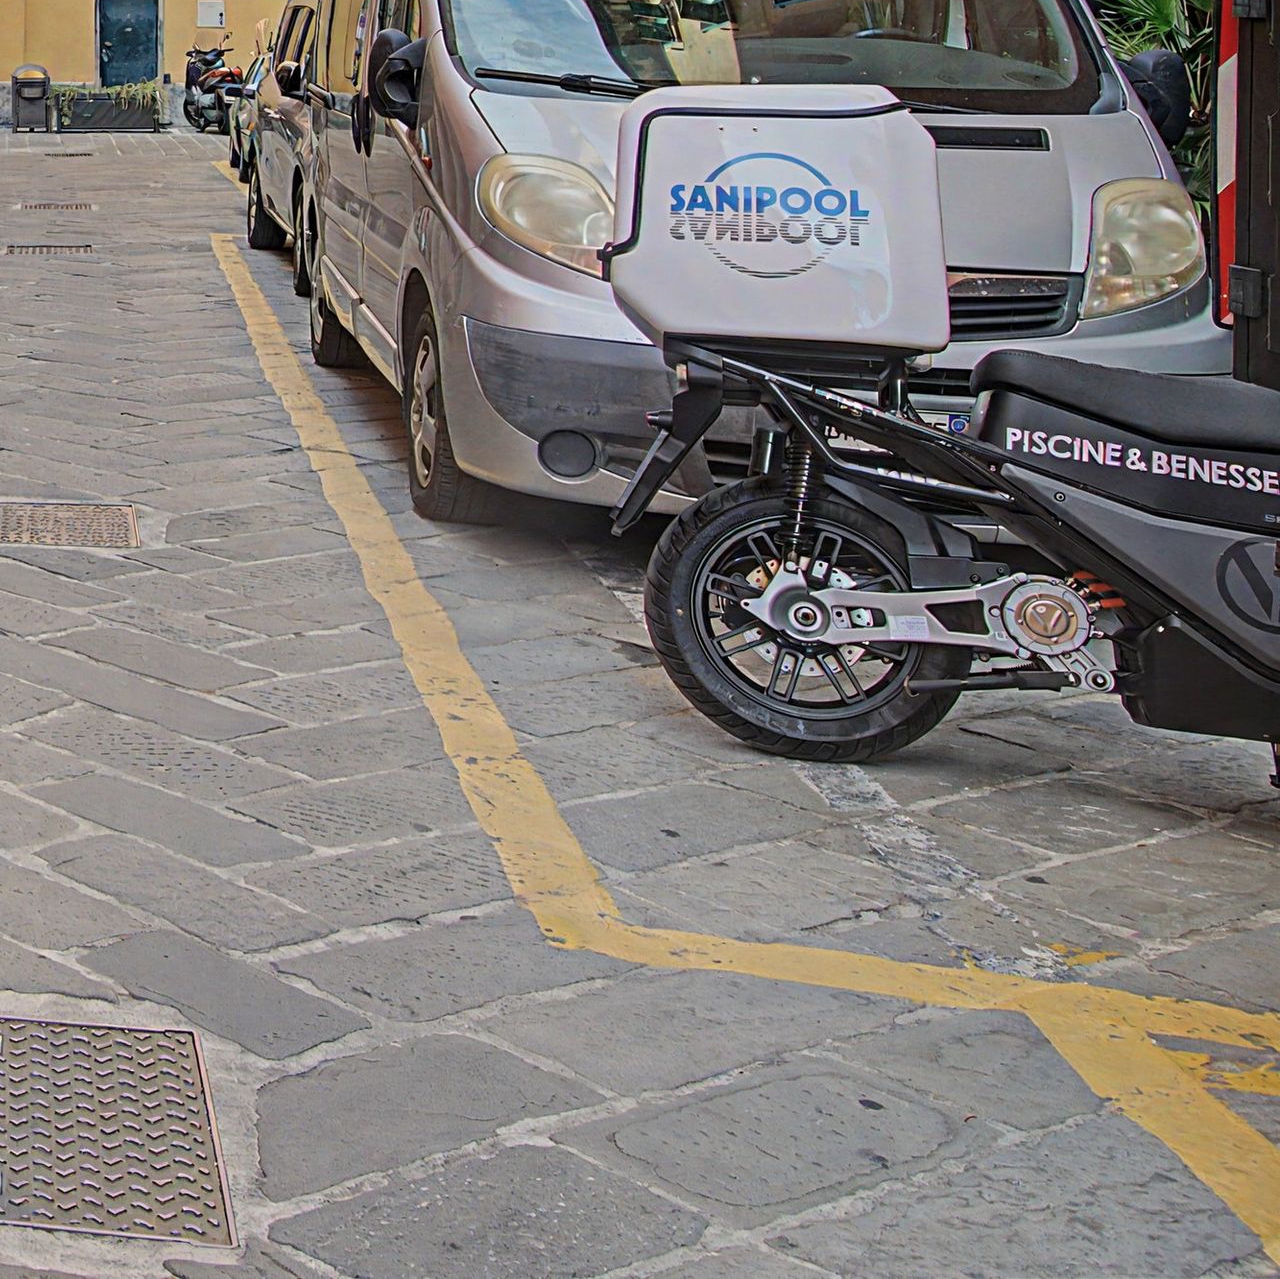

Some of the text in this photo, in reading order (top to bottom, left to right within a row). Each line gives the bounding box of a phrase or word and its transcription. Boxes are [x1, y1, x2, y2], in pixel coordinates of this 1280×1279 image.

[669, 184, 870, 217] SANIPOOL
[1005, 426, 1123, 467] PISCINE
[1151, 450, 1280, 496] BENESSE
